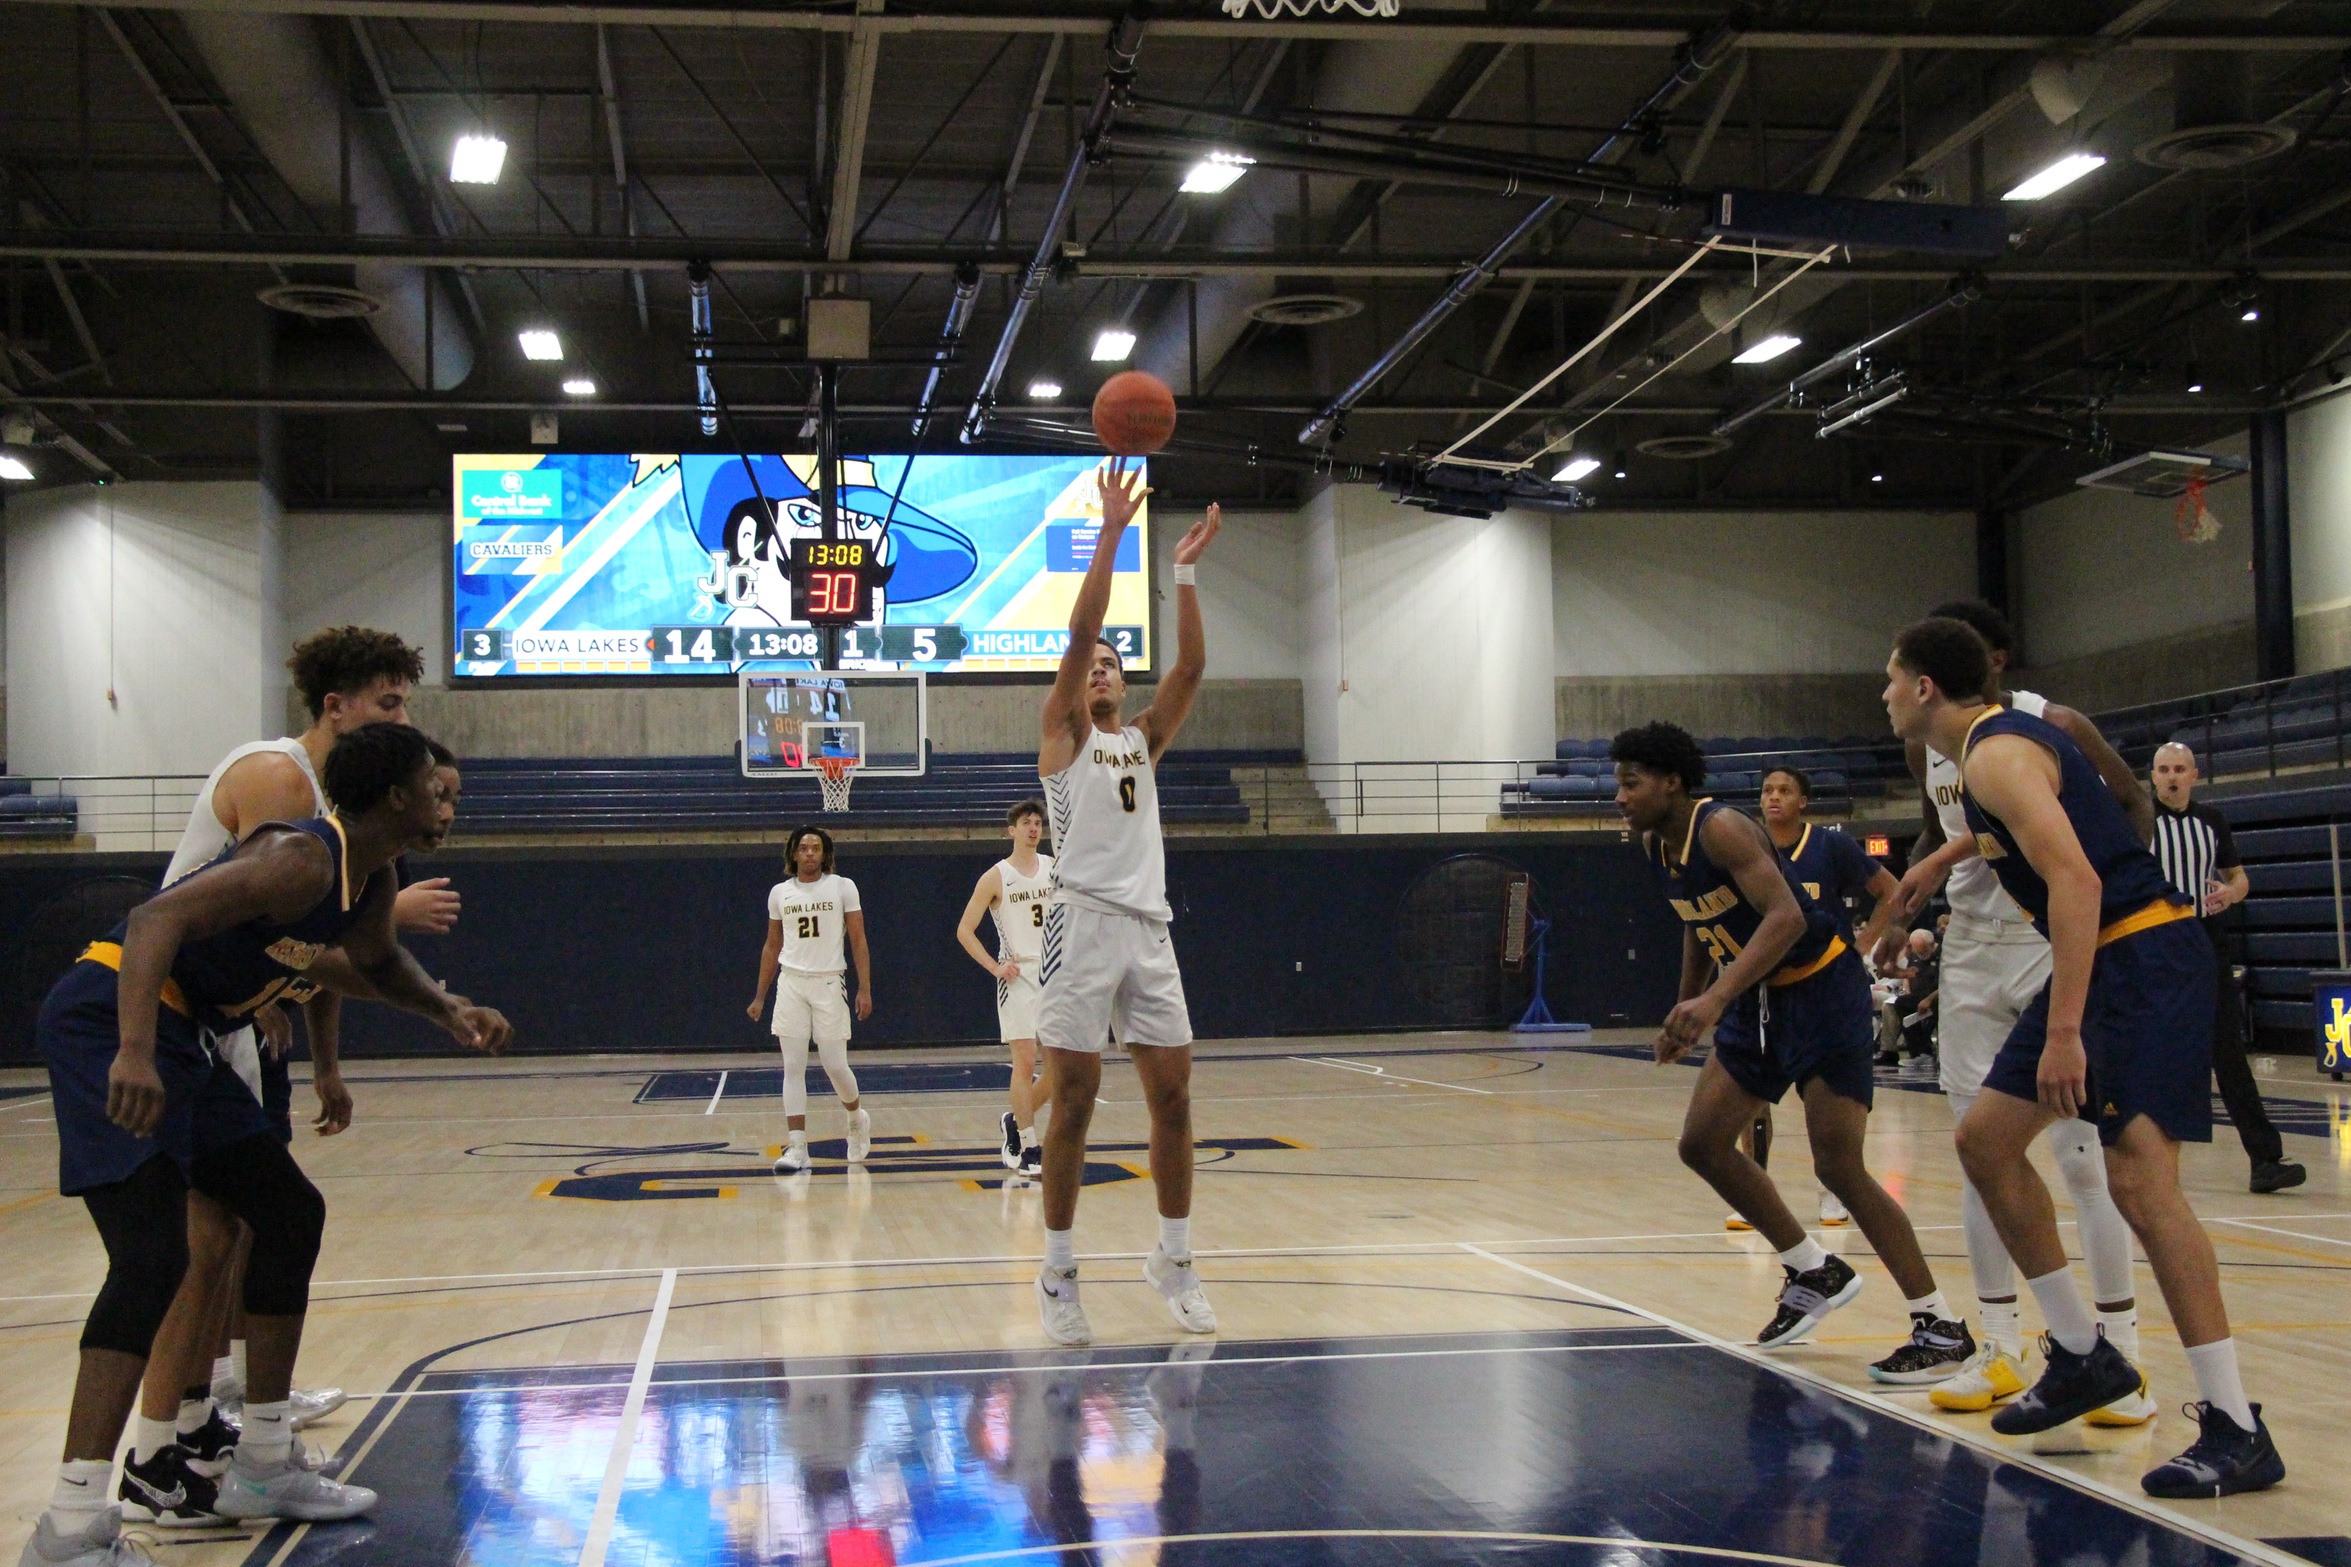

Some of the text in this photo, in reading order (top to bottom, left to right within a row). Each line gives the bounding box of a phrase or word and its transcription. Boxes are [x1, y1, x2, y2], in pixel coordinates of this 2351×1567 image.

[472, 544, 552, 555] CAVALIERS
[808, 544, 863, 566] 13:08
[808, 573, 857, 613] 30
[473, 634, 491, 656] 3
[516, 638, 639, 653] IOWA LAKES
[664, 629, 717, 664] 14
[749, 633, 819, 656] 13:08
[843, 629, 864, 657] 1
[912, 628, 937, 662] 5
[973, 633, 1071, 654] HIGHLAN
[1116, 631, 1133, 653] 2
[1119, 775, 1136, 813] 0
[1935, 784, 1962, 806] IOW
[1870, 840, 1885, 854] EXIT
[1009, 887, 1057, 903] IOWA LAK
[784, 902, 834, 915] IOWA LAKES
[1031, 904, 1043, 927] 3
[798, 915, 820, 938] 21
